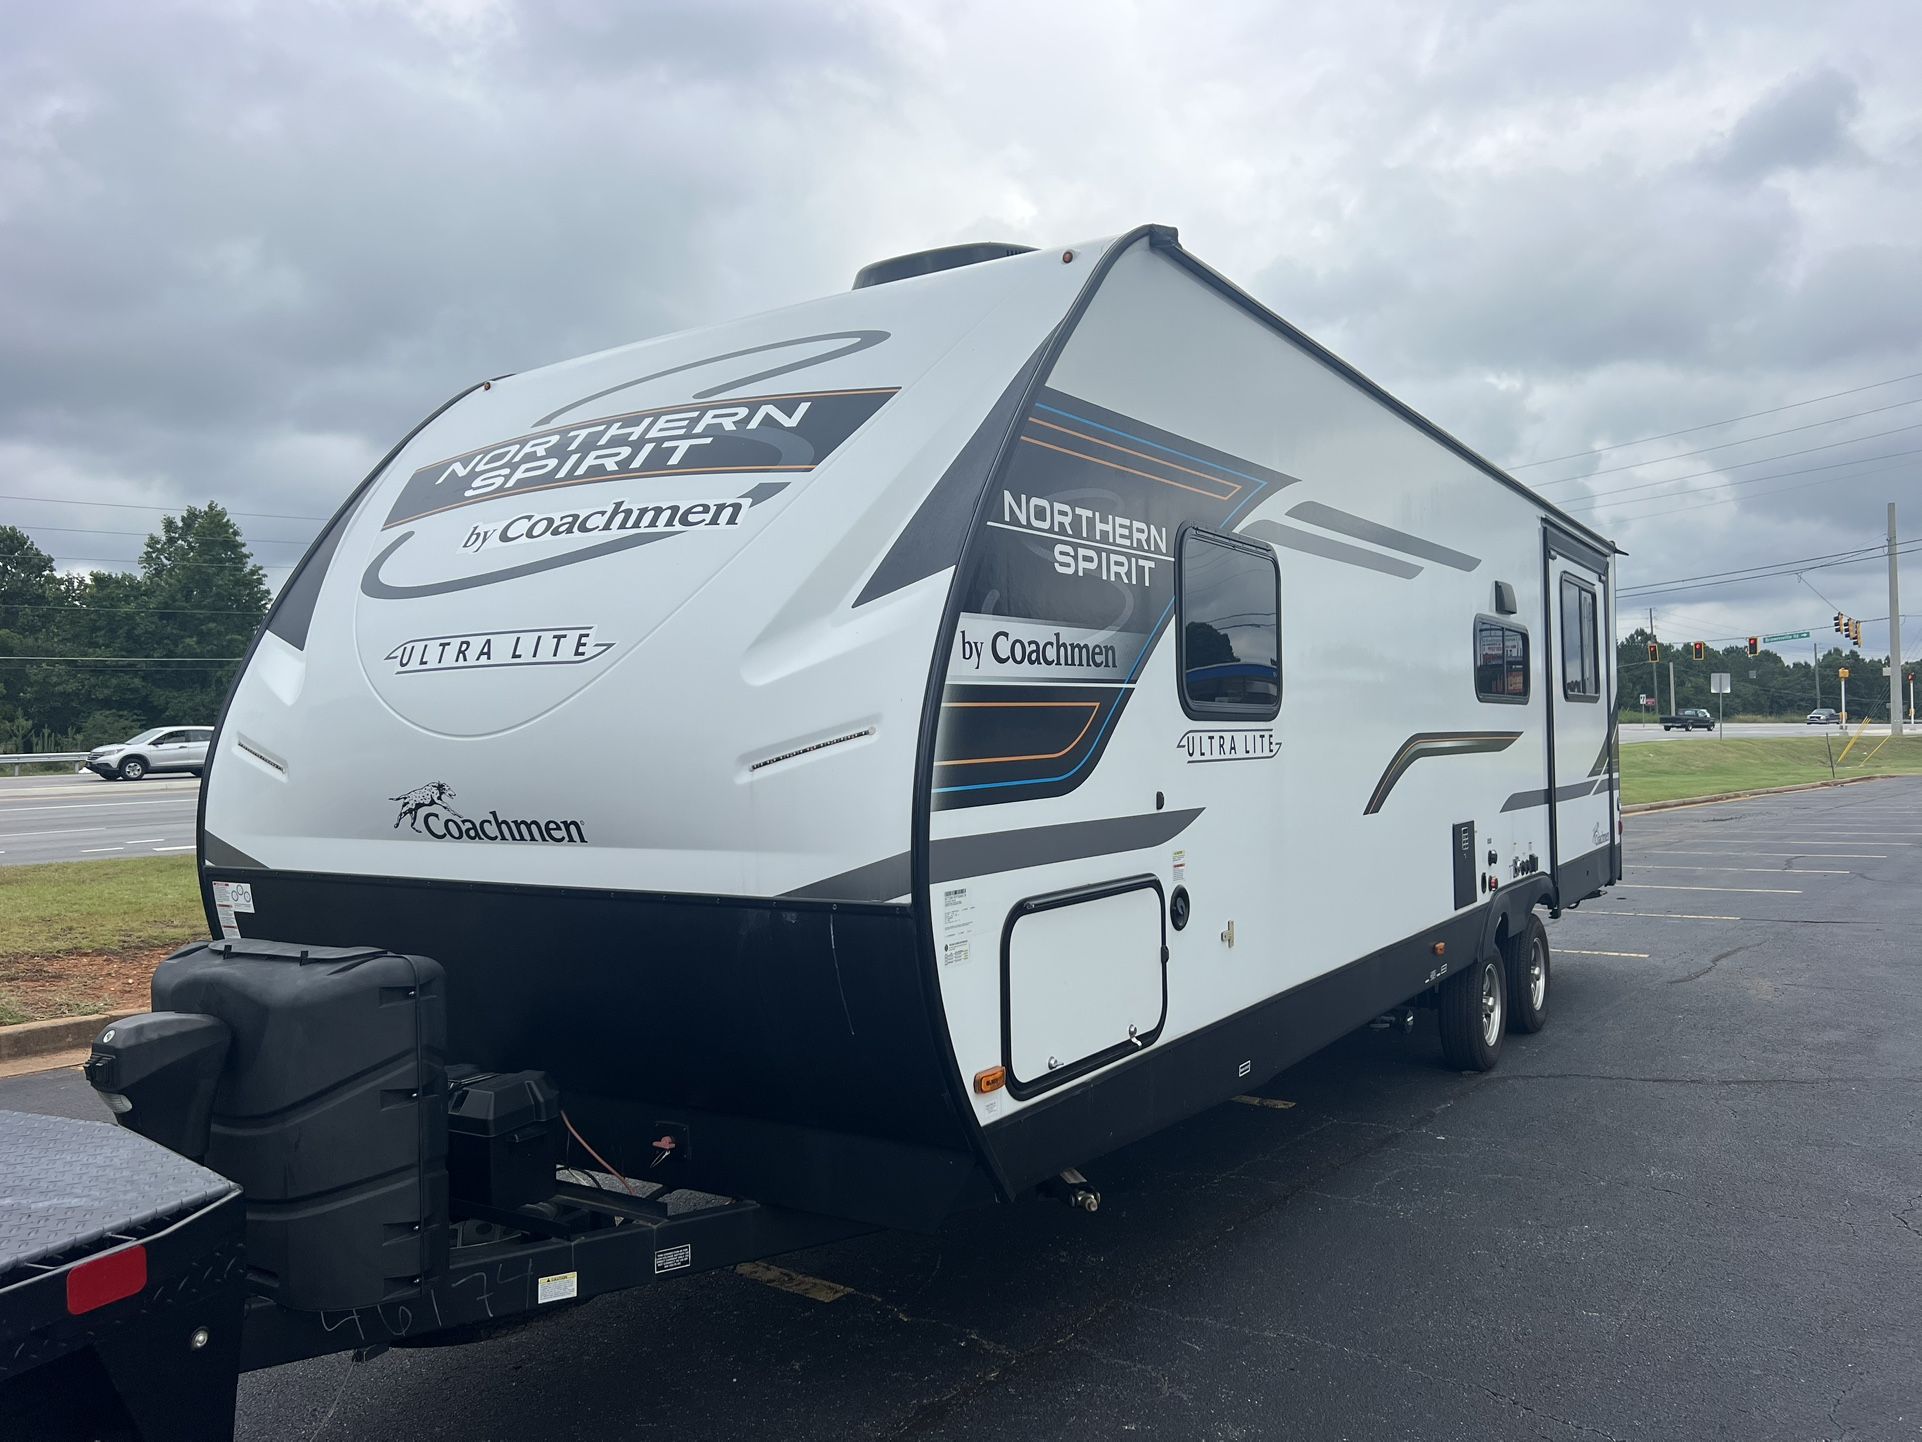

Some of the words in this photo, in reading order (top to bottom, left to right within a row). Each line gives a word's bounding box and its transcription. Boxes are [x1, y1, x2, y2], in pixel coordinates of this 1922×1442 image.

[435, 401, 811, 485] NORTHERN
[464, 437, 713, 498] SPIRIT
[462, 524, 498, 553] by
[498, 498, 743, 545] Coachmen
[1003, 489, 1167, 553] NORTHERN
[1053, 545, 1156, 587] SPIRIT
[399, 638, 493, 668] ULTRA
[511, 632, 591, 661] LITE
[960, 630, 985, 670] by
[991, 630, 1118, 669] Coachmen
[1187, 735, 1237, 758] ULTRA
[1244, 733, 1275, 755] LITE
[423, 810, 588, 843] Coachmen
